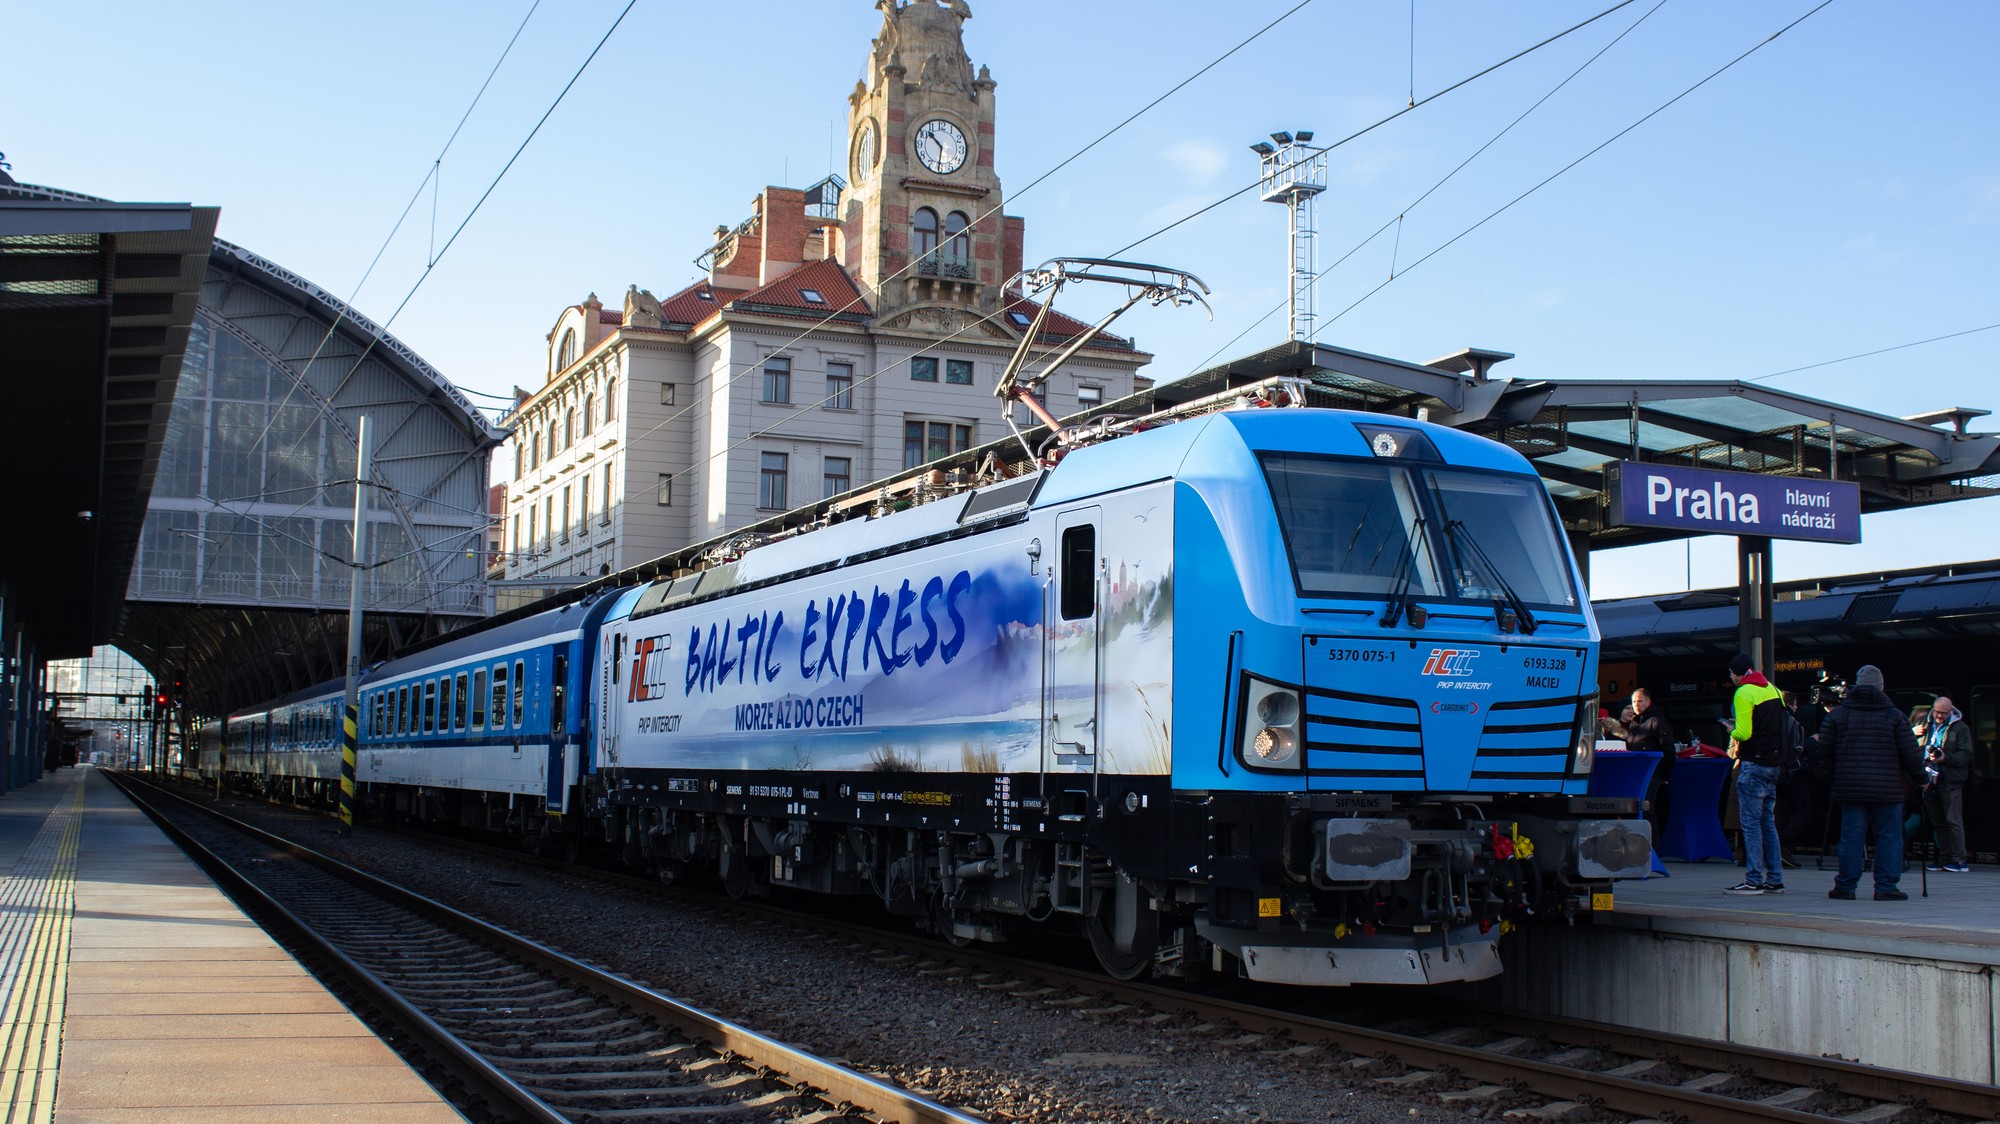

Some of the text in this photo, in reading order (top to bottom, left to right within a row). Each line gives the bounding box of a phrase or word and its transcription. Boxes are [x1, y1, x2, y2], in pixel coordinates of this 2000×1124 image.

[938, 121, 946, 130] 12
[917, 140, 922, 149] 9
[956, 134, 961, 143] 2
[959, 146, 964, 154] 3
[1648, 475, 1760, 524] Praha
[1786, 488, 1830, 508] hlavní
[1782, 511, 1836, 530] nádraží
[685, 570, 971, 698] BALTIC EXPRESS
[1328, 649, 1395, 662] 5370 075-1
[1524, 658, 1566, 670] 6193.328
[1526, 676, 1560, 688] MACIEJ
[1670, 682, 1697, 692] Business
[735, 692, 864, 732] MORZE AŻ DO CZECH
[1440, 704, 1469, 712] CARGOUNIT
[638, 714, 682, 734] PKP INTERCITY
[1585, 801, 1616, 810] Vectron
